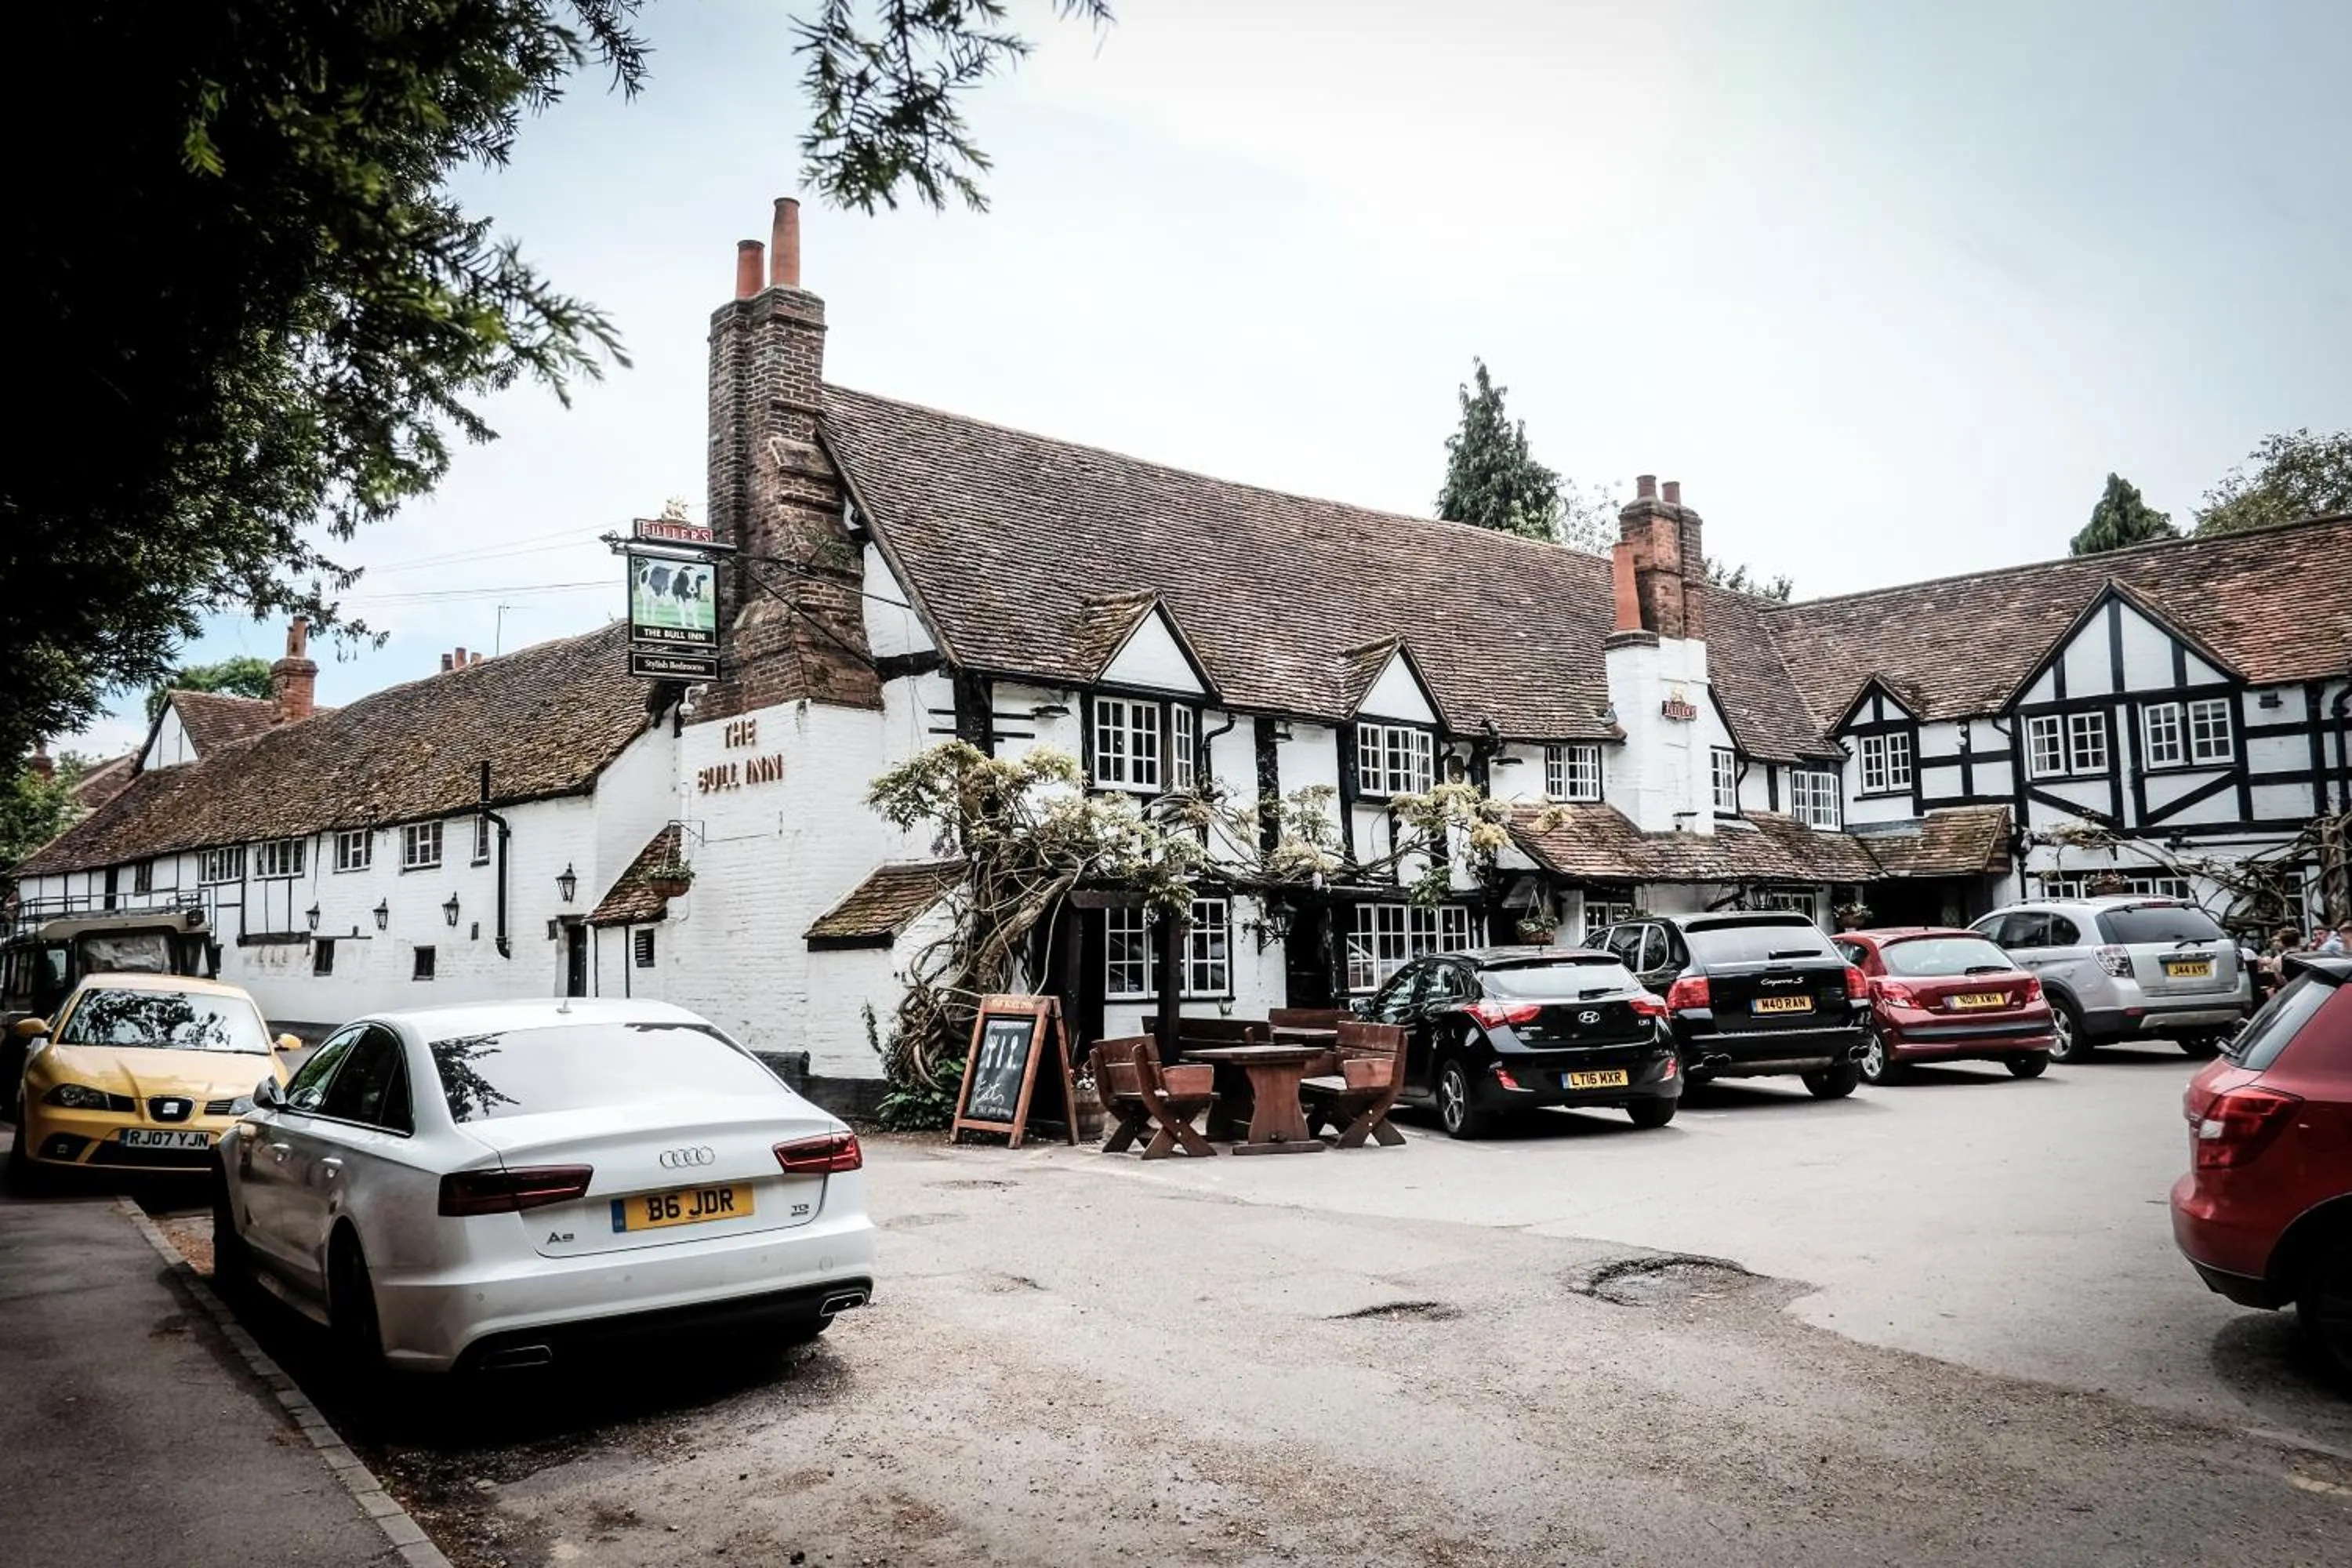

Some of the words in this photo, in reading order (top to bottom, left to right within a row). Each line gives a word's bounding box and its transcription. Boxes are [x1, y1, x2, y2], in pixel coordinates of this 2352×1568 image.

[644, 628, 662, 637] THE
[664, 630, 685, 639] BULL
[688, 631, 706, 641] INN
[724, 718, 757, 748] THE
[698, 762, 741, 794] BULL
[746, 753, 782, 785] INN
[1784, 996, 1806, 1008] RAN
[1599, 1071, 1622, 1083] MXR
[129, 1131, 170, 1145] RJ07
[176, 1132, 209, 1147] YJN
[647, 1195, 681, 1221] B6
[688, 1189, 734, 1215] JDR
